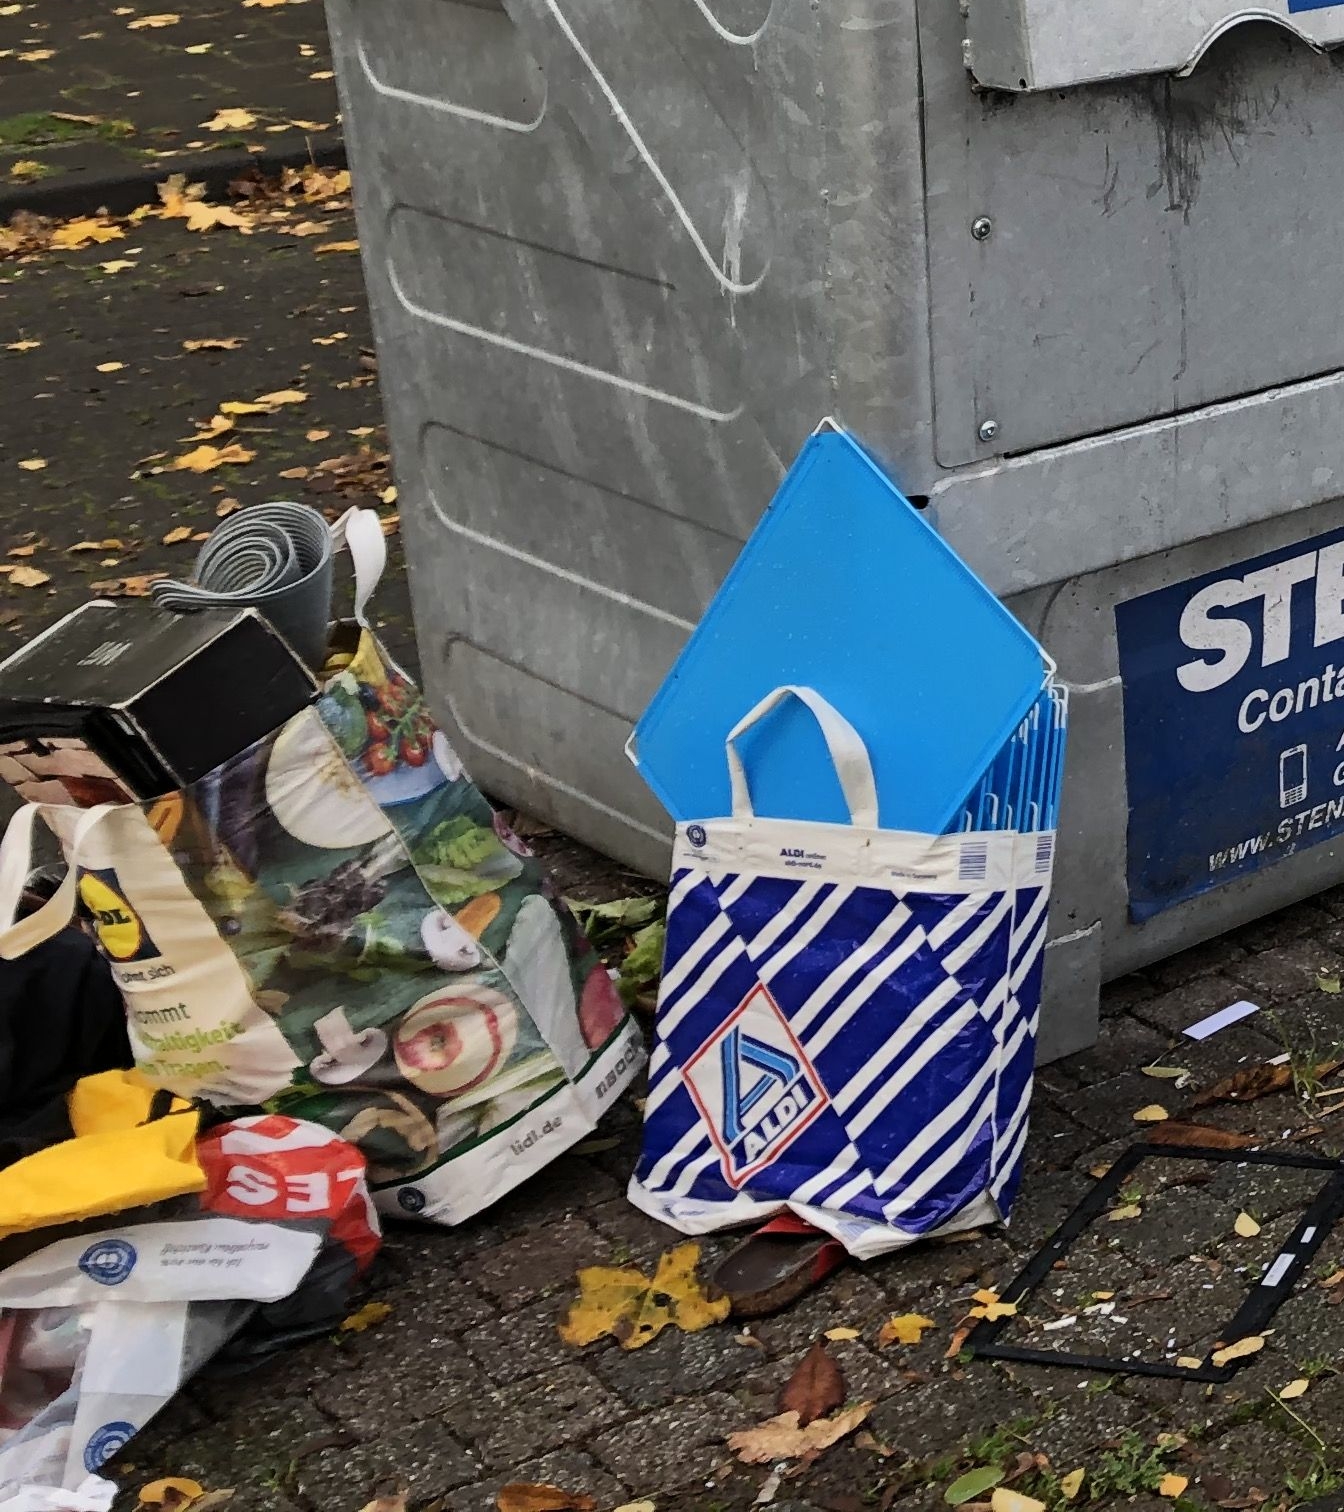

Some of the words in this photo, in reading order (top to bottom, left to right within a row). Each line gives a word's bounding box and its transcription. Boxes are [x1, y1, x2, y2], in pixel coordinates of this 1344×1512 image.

[780, 849, 804, 858] ALDI
[121, 970, 145, 984] ohnt
[136, 1002, 191, 1025] ommt
[744, 1082, 809, 1164] ALDI
[510, 1115, 562, 1156] lidl.de
